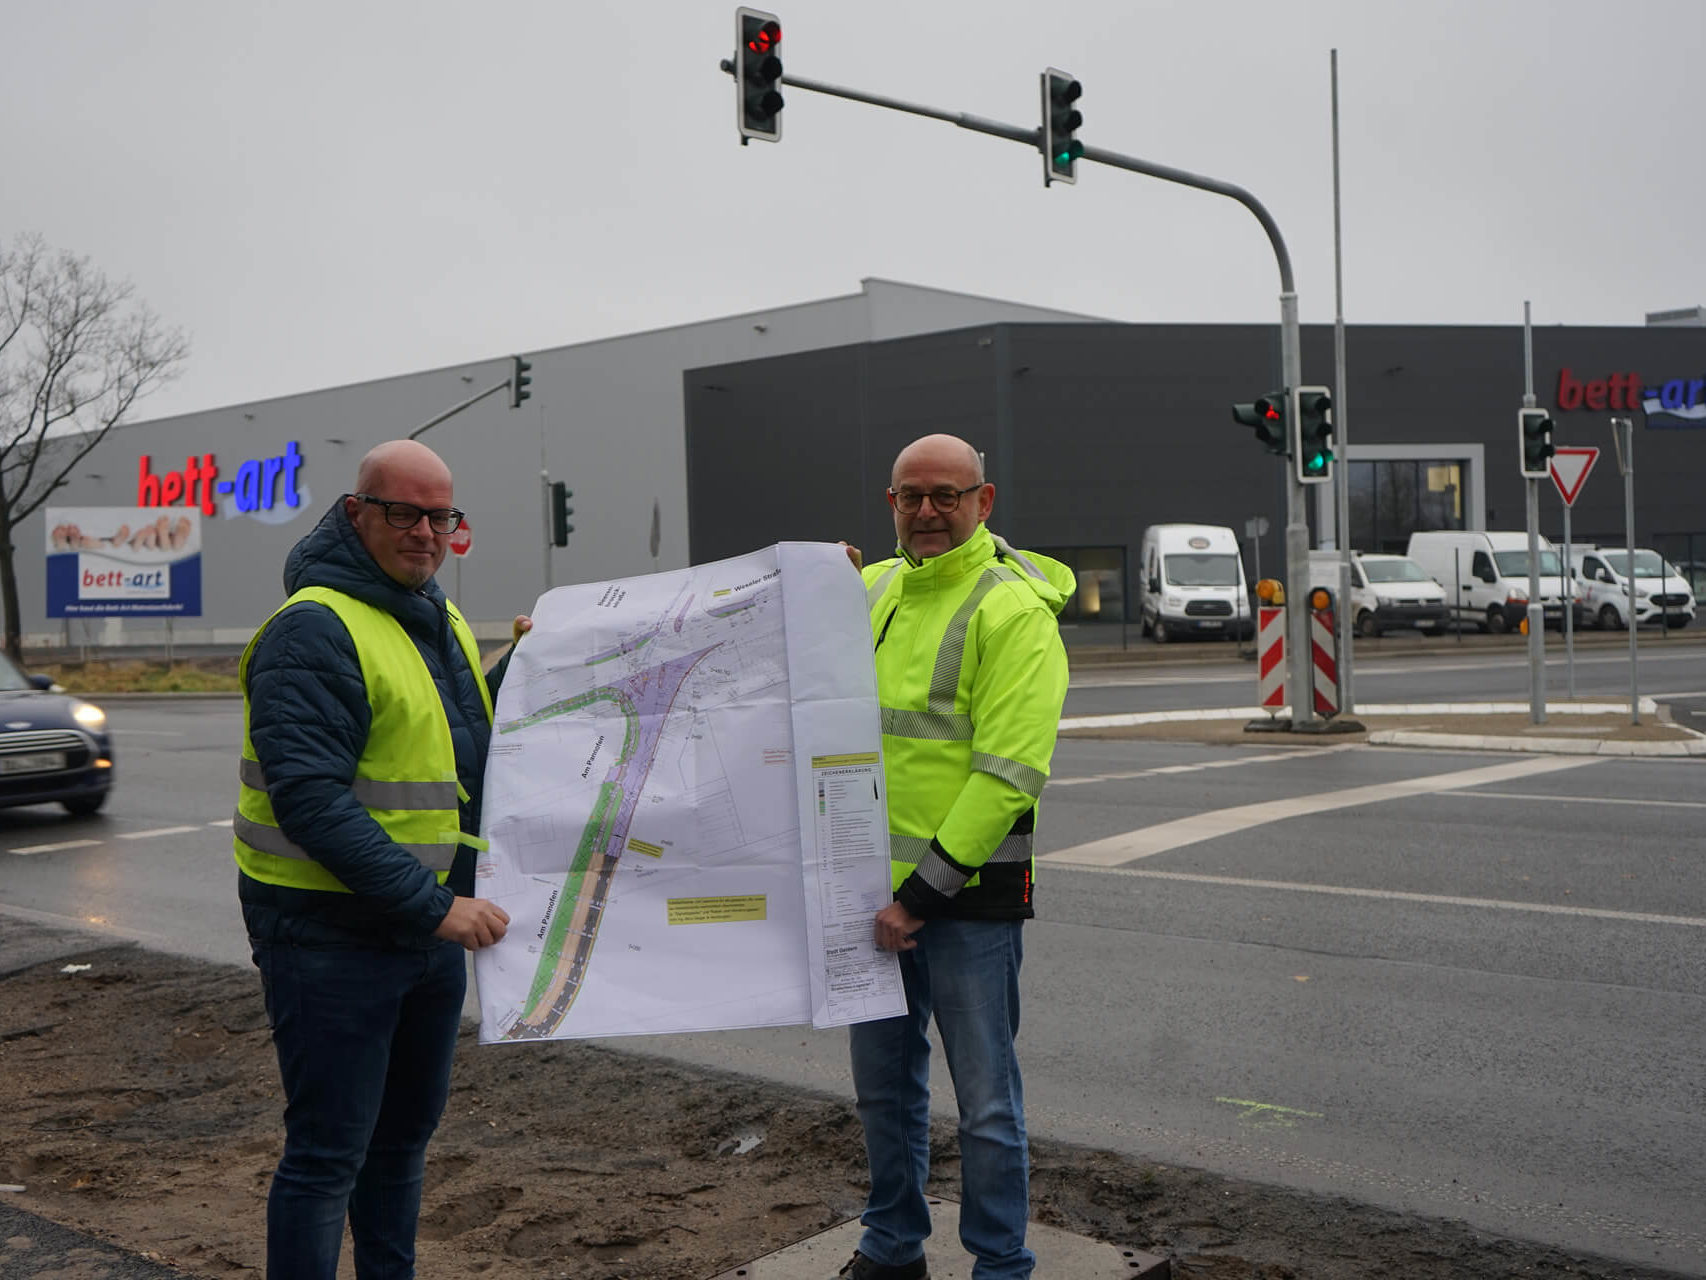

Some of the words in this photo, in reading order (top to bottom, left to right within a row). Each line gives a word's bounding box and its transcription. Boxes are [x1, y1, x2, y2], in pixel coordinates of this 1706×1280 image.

[1558, 367, 1706, 409] bett-ar
[137, 441, 303, 516] bett-art
[83, 569, 162, 587] bett-art
[581, 766, 591, 779] Am
[586, 735, 605, 766] Pannofen
[541, 890, 558, 925] Pannofen
[537, 926, 546, 940] Am
